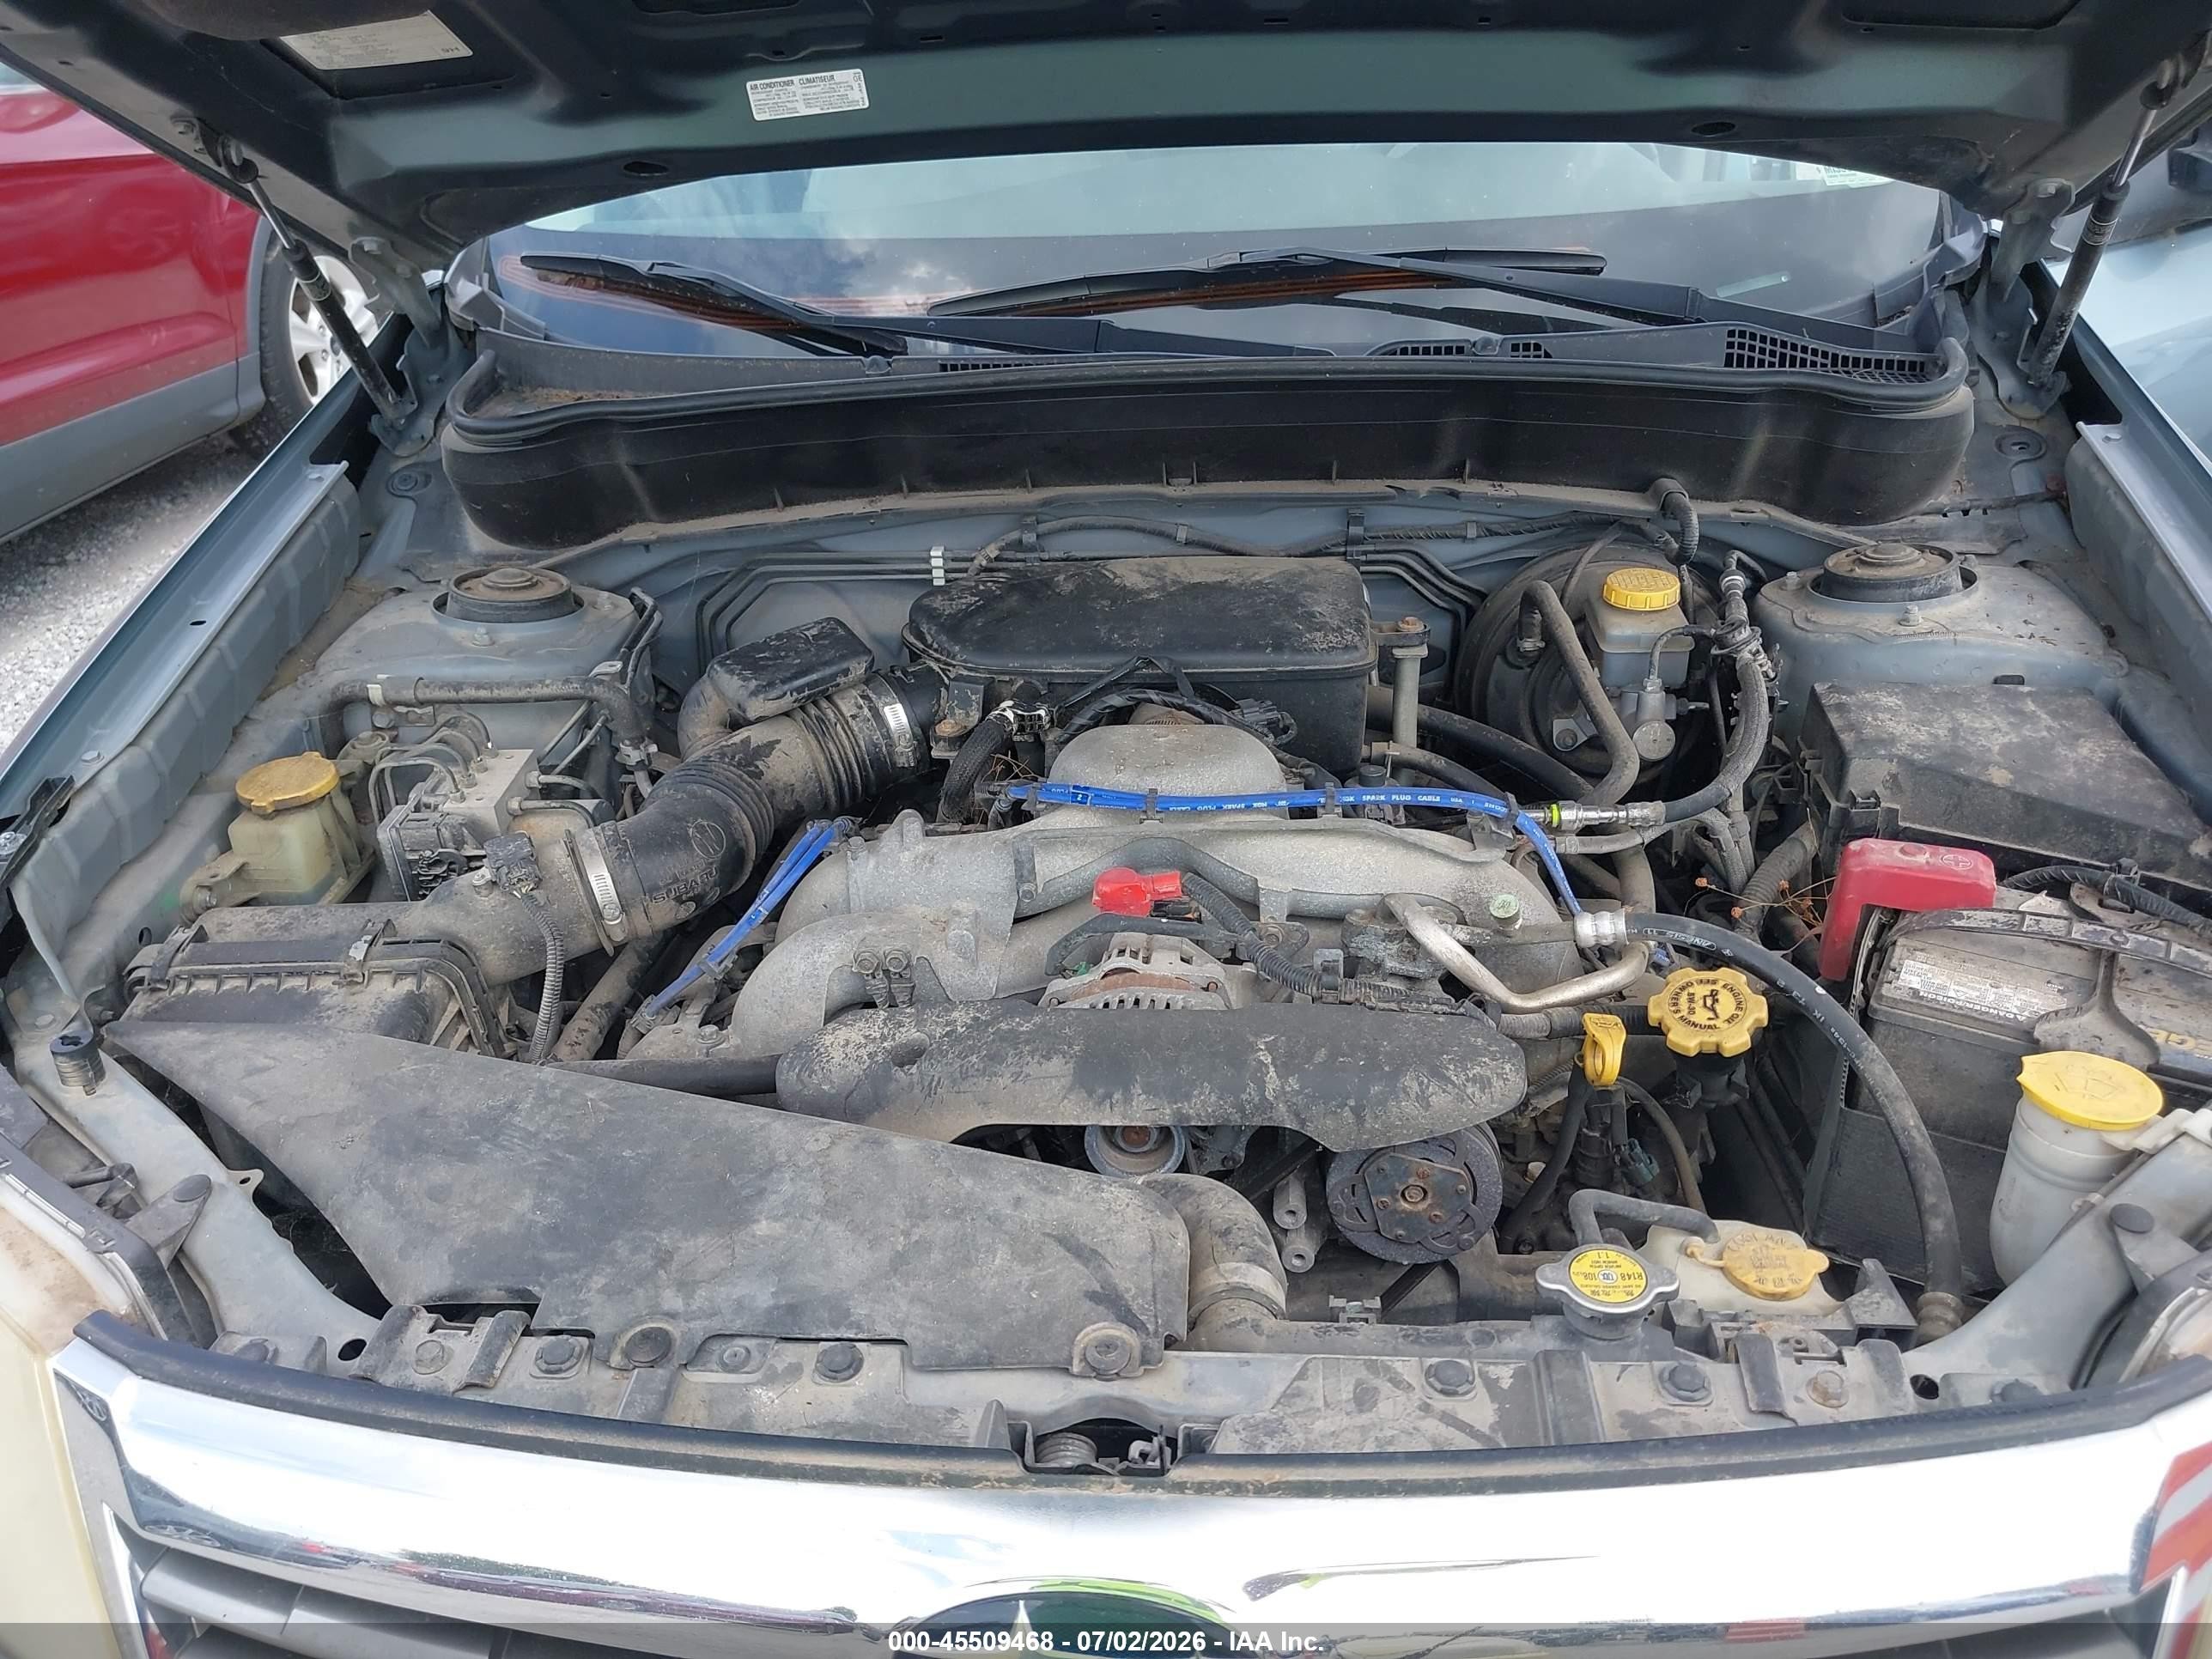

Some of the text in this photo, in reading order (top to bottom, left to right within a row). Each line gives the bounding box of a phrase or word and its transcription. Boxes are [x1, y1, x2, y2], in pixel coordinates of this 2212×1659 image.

[759, 79, 795, 89] CONDITIONER
[799, 75, 836, 85] CLIMATISEUR
[652, 867, 719, 903] SUBARU
[1670, 981, 1693, 1015] OWNER'S
[1686, 992, 1696, 1016] 5W-30
[1722, 982, 1742, 1024] ENGINE OIL
[1679, 1015, 1721, 1030] MANUAL
[1620, 1272, 1644, 1281] R148
